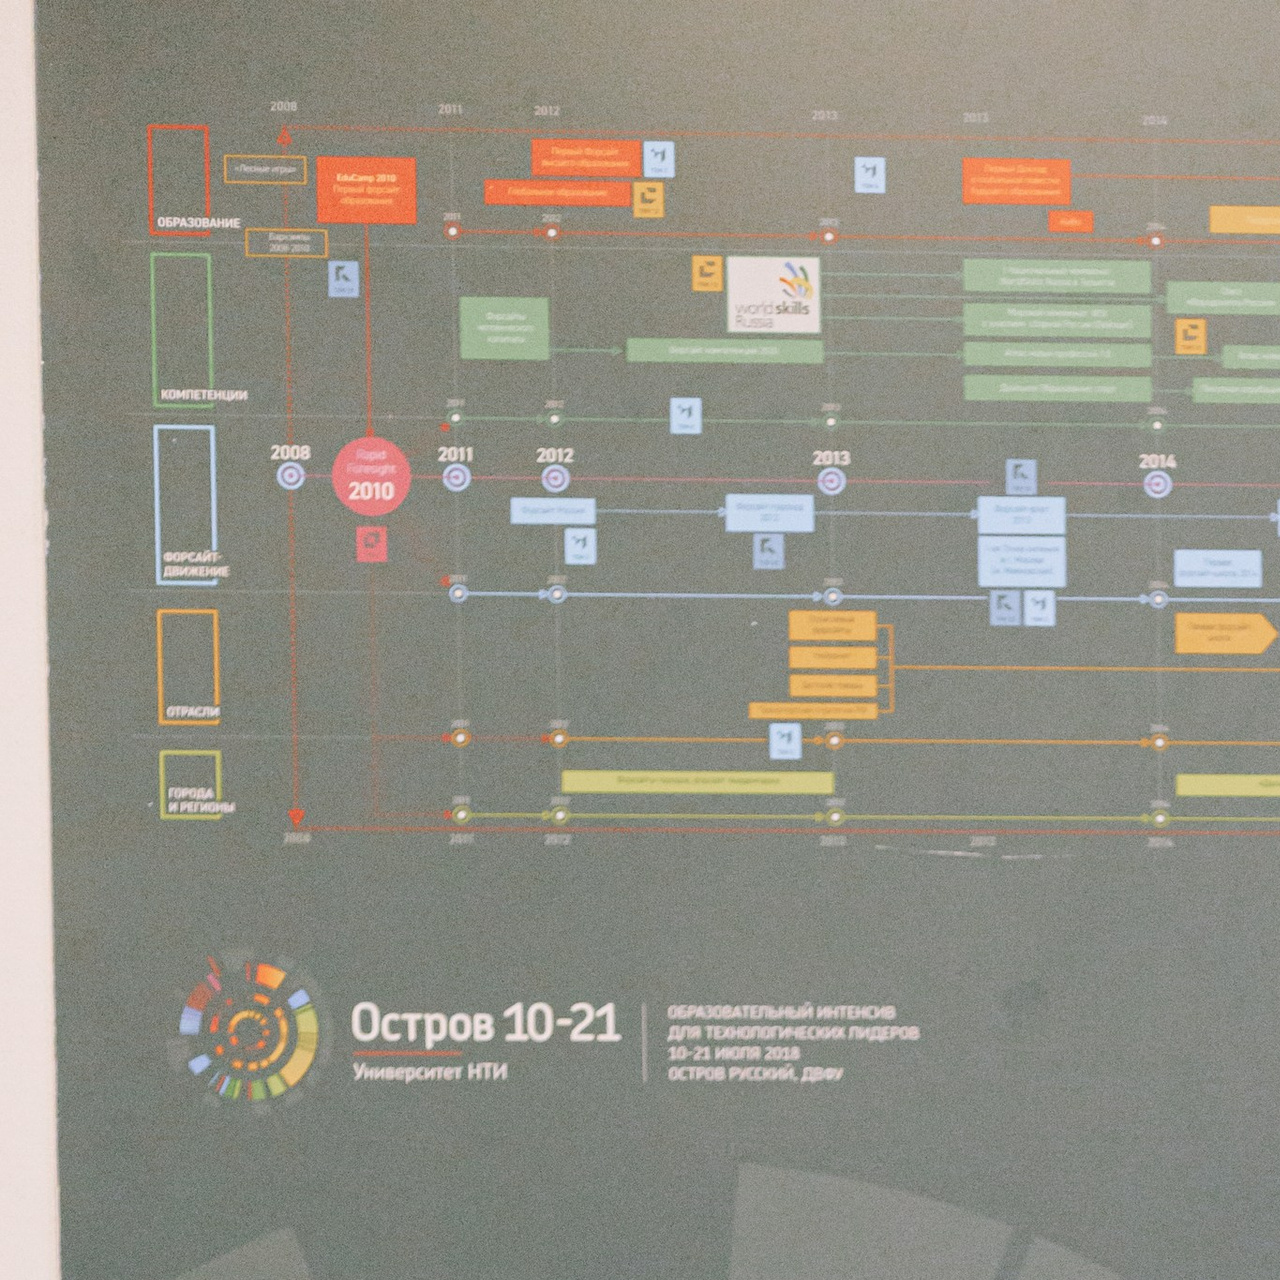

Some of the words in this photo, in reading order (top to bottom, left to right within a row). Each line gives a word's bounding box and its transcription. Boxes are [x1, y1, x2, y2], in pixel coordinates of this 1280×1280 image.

[534, 105, 561, 116] 2012
[157, 217, 242, 229] ОБРАЗОВАНИЕ
[160, 389, 248, 402] КОМПЕТЕНЦИИ
[270, 445, 311, 460] 2008
[438, 447, 473, 462] 2011
[536, 448, 574, 463] 2012
[813, 450, 851, 466] 2013
[1139, 454, 1177, 469] 2014
[349, 482, 395, 500] 2010
[166, 705, 220, 718] ОТРАСЛИ
[168, 787, 214, 800] ГОРОДА
[168, 801, 177, 812] И
[179, 802, 236, 814] РЕГИОНЫ
[667, 1002, 814, 1020] ОБРАЗОВАТЕЛЬНЫЙ
[816, 1004, 896, 1020] ИНТЕНСИВ
[351, 1000, 496, 1050] Остров
[503, 1001, 622, 1044] 10-21
[667, 1025, 701, 1042] ДЛЯ
[705, 1025, 846, 1041] ТЕХНОЛОГИЧЕСКИХ
[848, 1025, 921, 1042] ЛИДЕРОВ
[667, 1045, 711, 1061] 10-21
[714, 1045, 762, 1061] ИЮЛЯ
[353, 1062, 463, 1084] Университет
[468, 1062, 509, 1080] НТИ
[668, 1066, 727, 1081] ОСТРОВ
[729, 1063, 799, 1082] РУССКИЙ,
[801, 1066, 845, 1082] ДВФУ
